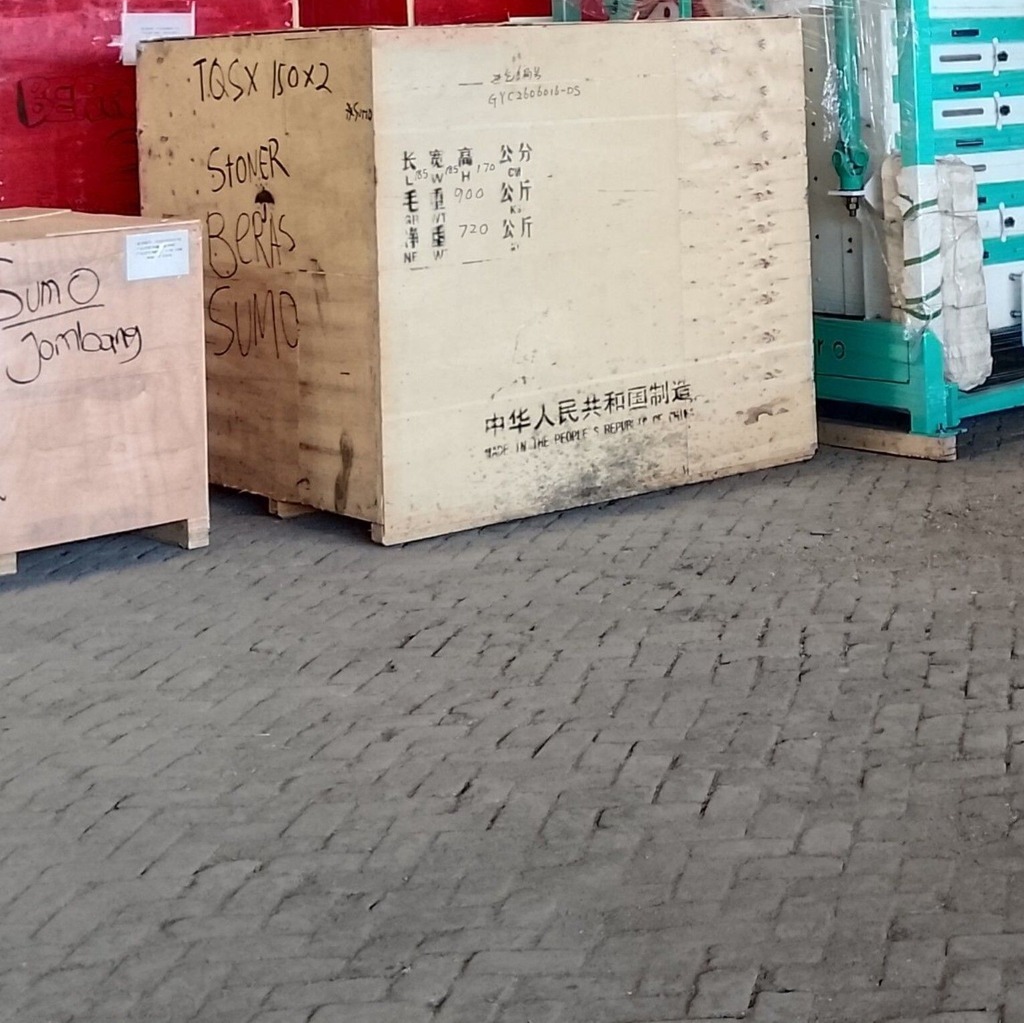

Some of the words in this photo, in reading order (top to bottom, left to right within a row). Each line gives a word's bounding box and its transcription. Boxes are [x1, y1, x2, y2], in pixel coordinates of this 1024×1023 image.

[459, 223, 488, 238] 720
[208, 285, 300, 359] SUMO
[485, 380, 693, 437] 中华人民共和国制造
